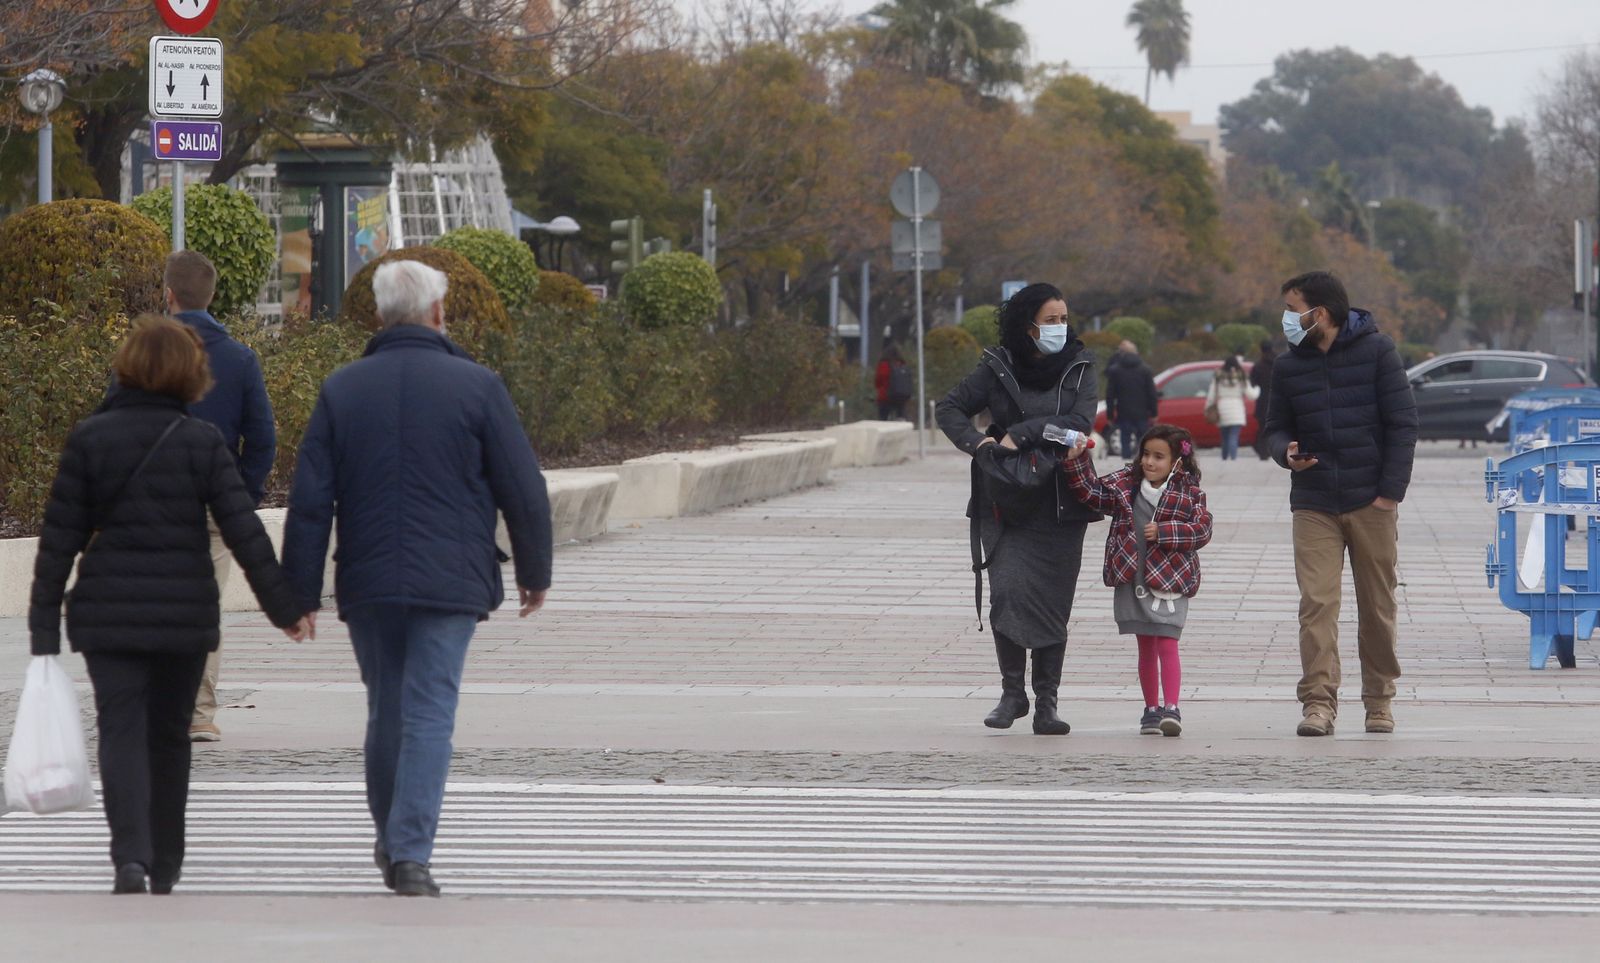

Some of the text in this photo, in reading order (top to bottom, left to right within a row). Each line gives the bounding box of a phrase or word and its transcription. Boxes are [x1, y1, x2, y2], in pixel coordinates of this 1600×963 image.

[162, 45, 216, 55] ATENCIÓN PEATÓN
[178, 132, 217, 151] SALIDA
